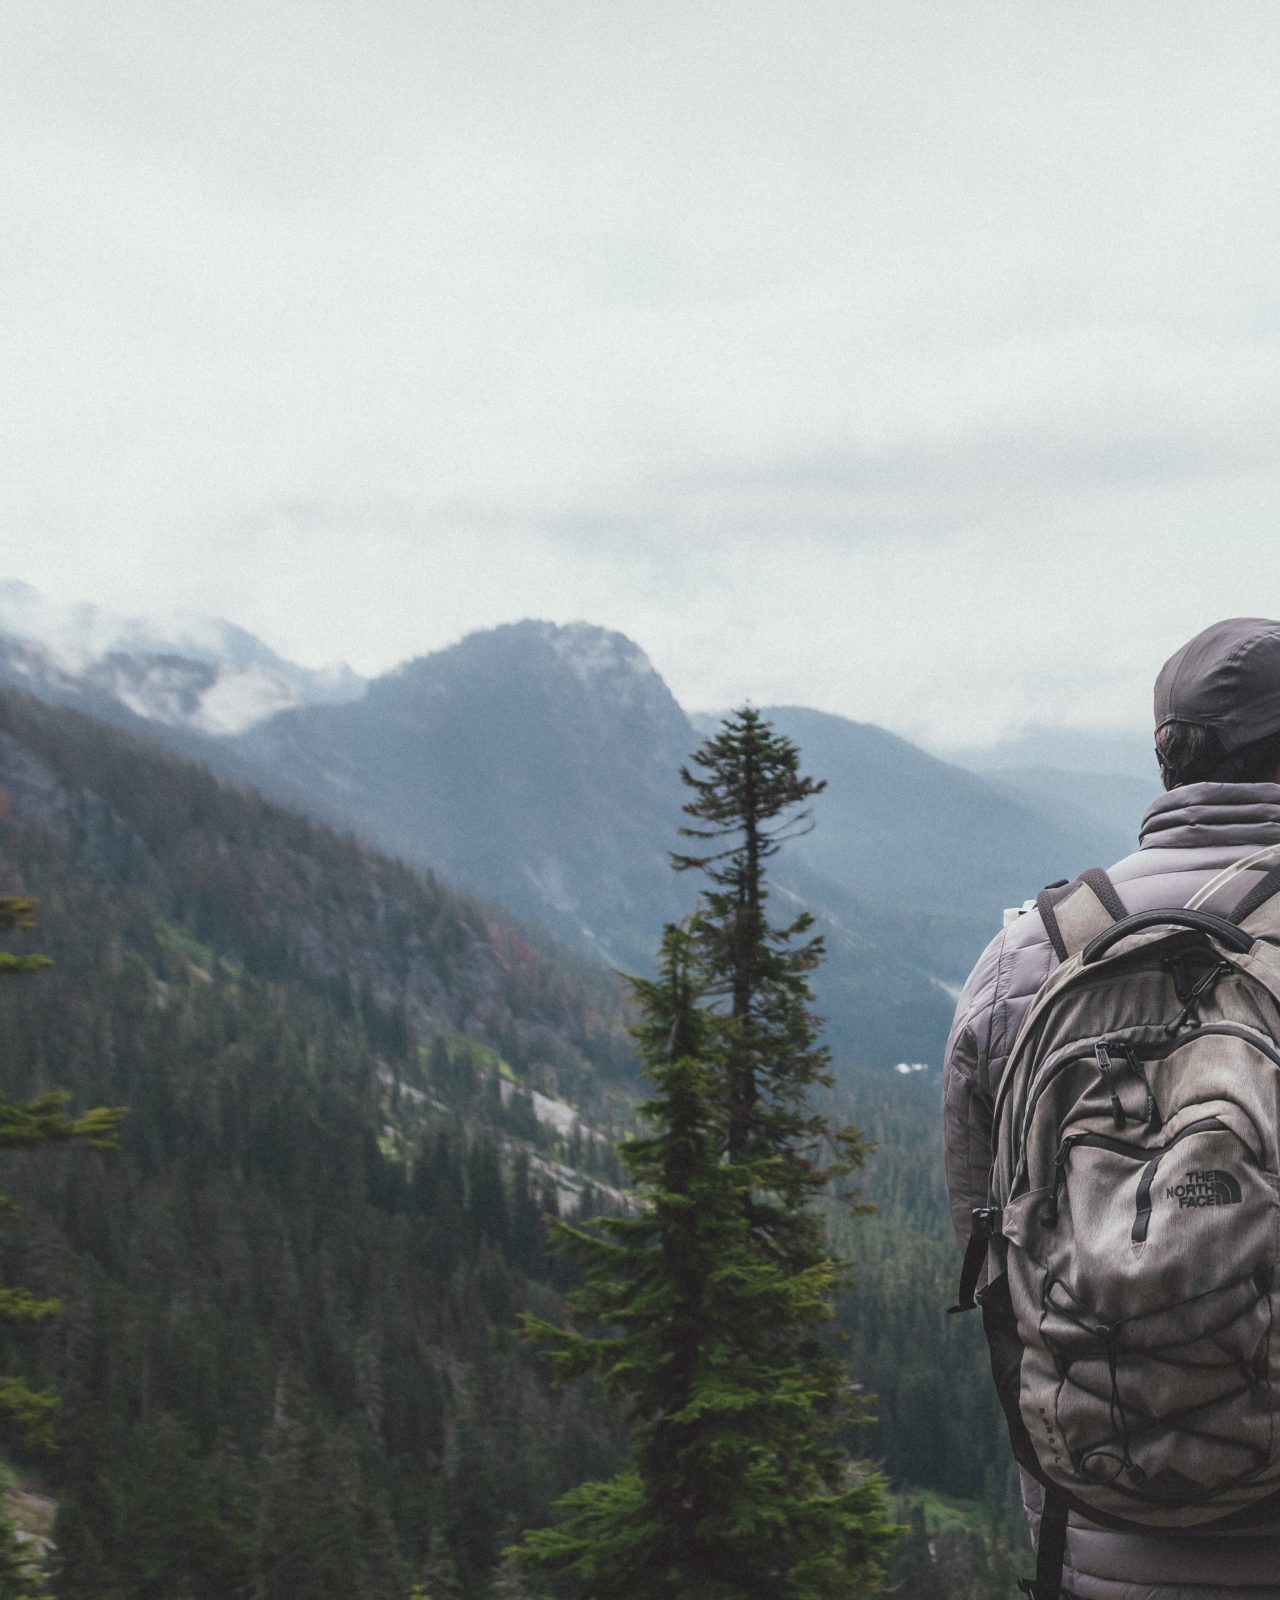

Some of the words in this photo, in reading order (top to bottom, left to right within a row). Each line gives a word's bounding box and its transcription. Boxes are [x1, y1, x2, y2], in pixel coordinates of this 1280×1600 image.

[1186, 1171, 1214, 1183] THE
[1166, 1183, 1215, 1199] NORTH
[1179, 1195, 1215, 1208] FACE
